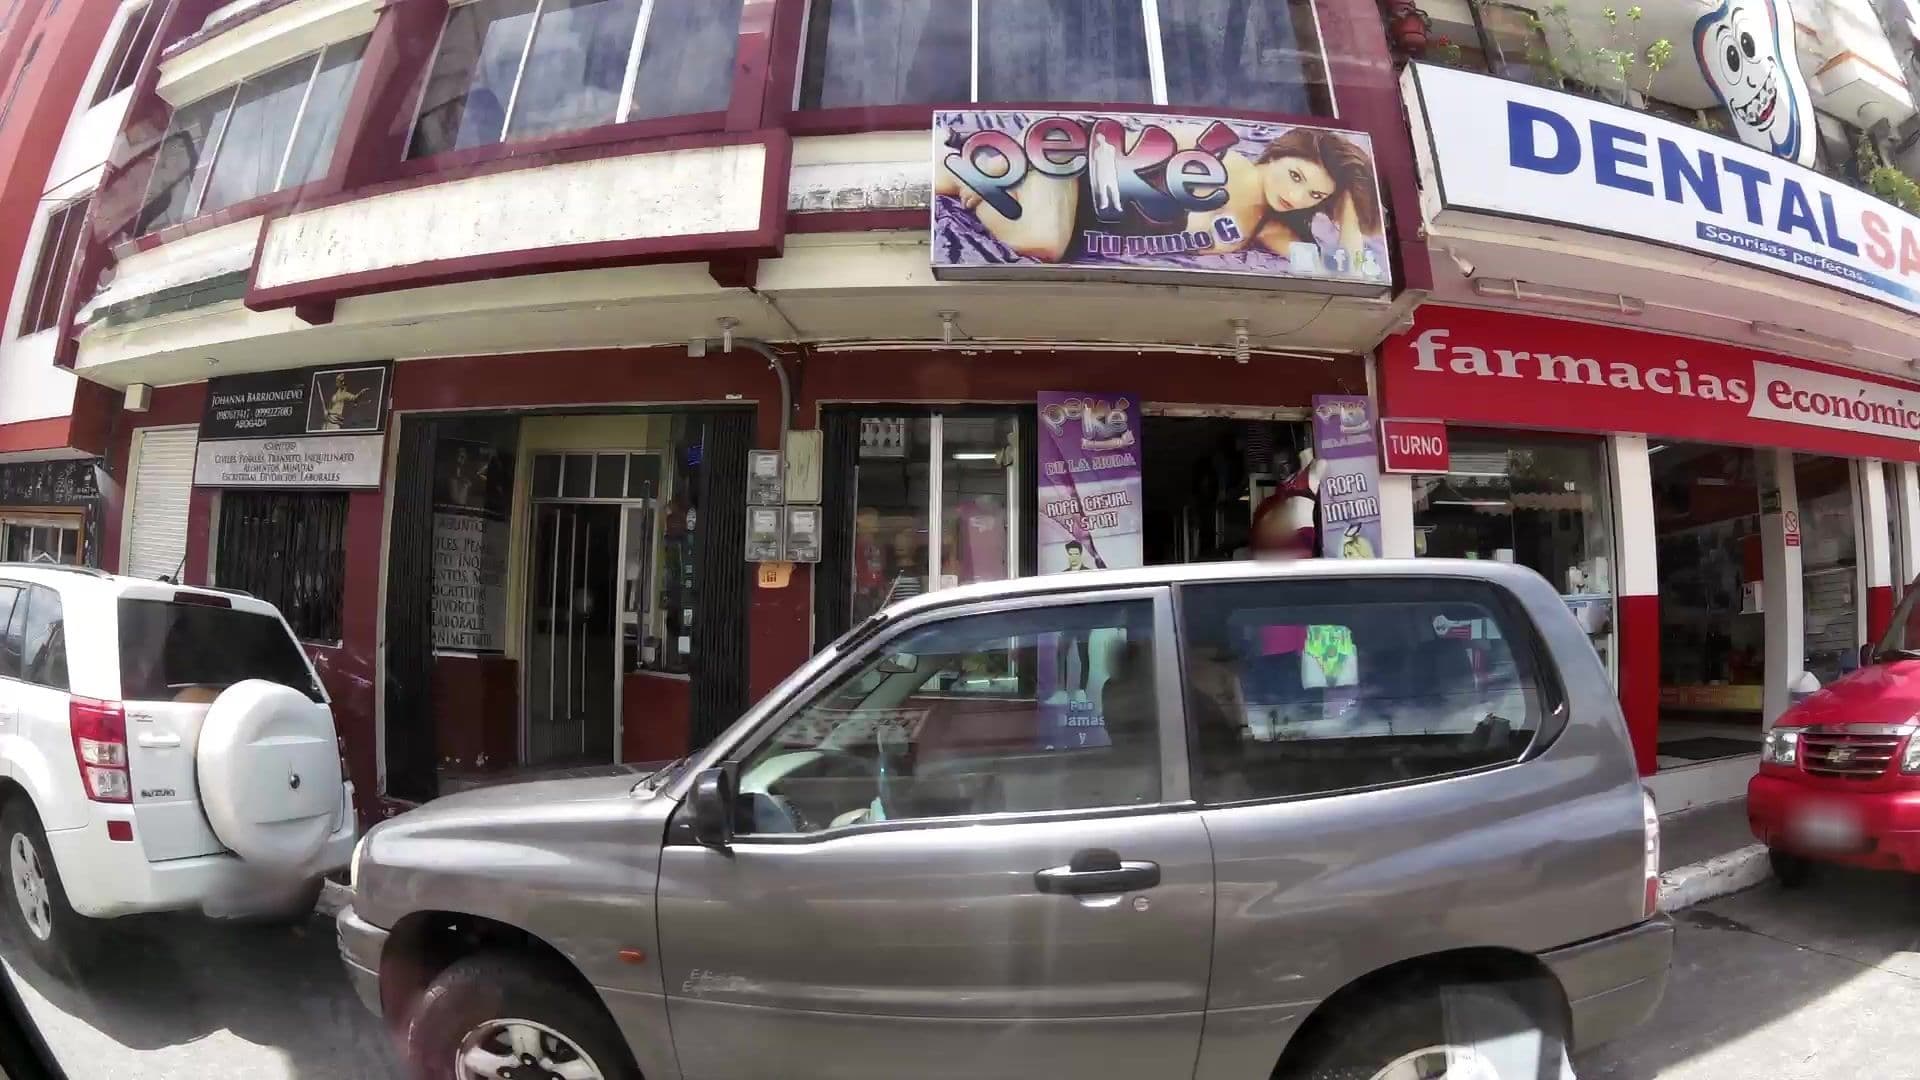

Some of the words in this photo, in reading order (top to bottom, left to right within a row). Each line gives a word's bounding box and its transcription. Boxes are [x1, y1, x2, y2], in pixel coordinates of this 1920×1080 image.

[1506, 100, 1861, 258] DENTAL
[1084, 230, 1121, 254] Tu
[1126, 230, 1212, 257] punto
[1213, 215, 1242, 243] G
[1704, 225, 1788, 258] Sonrisas
[1409, 328, 1749, 404] farmacias
[1767, 380, 1920, 431] económic
[212, 395, 246, 407] JOHANNA
[247, 389, 304, 402] BARRIONUEVO
[1389, 434, 1444, 457] TURNO
[1325, 473, 1368, 498] ROPA
[1046, 498, 1081, 519] ROPA
[1081, 490, 1133, 513] CASUAL
[1323, 496, 1381, 523] INTIMA
[1064, 518, 1075, 534] Y
[1081, 511, 1120, 531] SPORT
